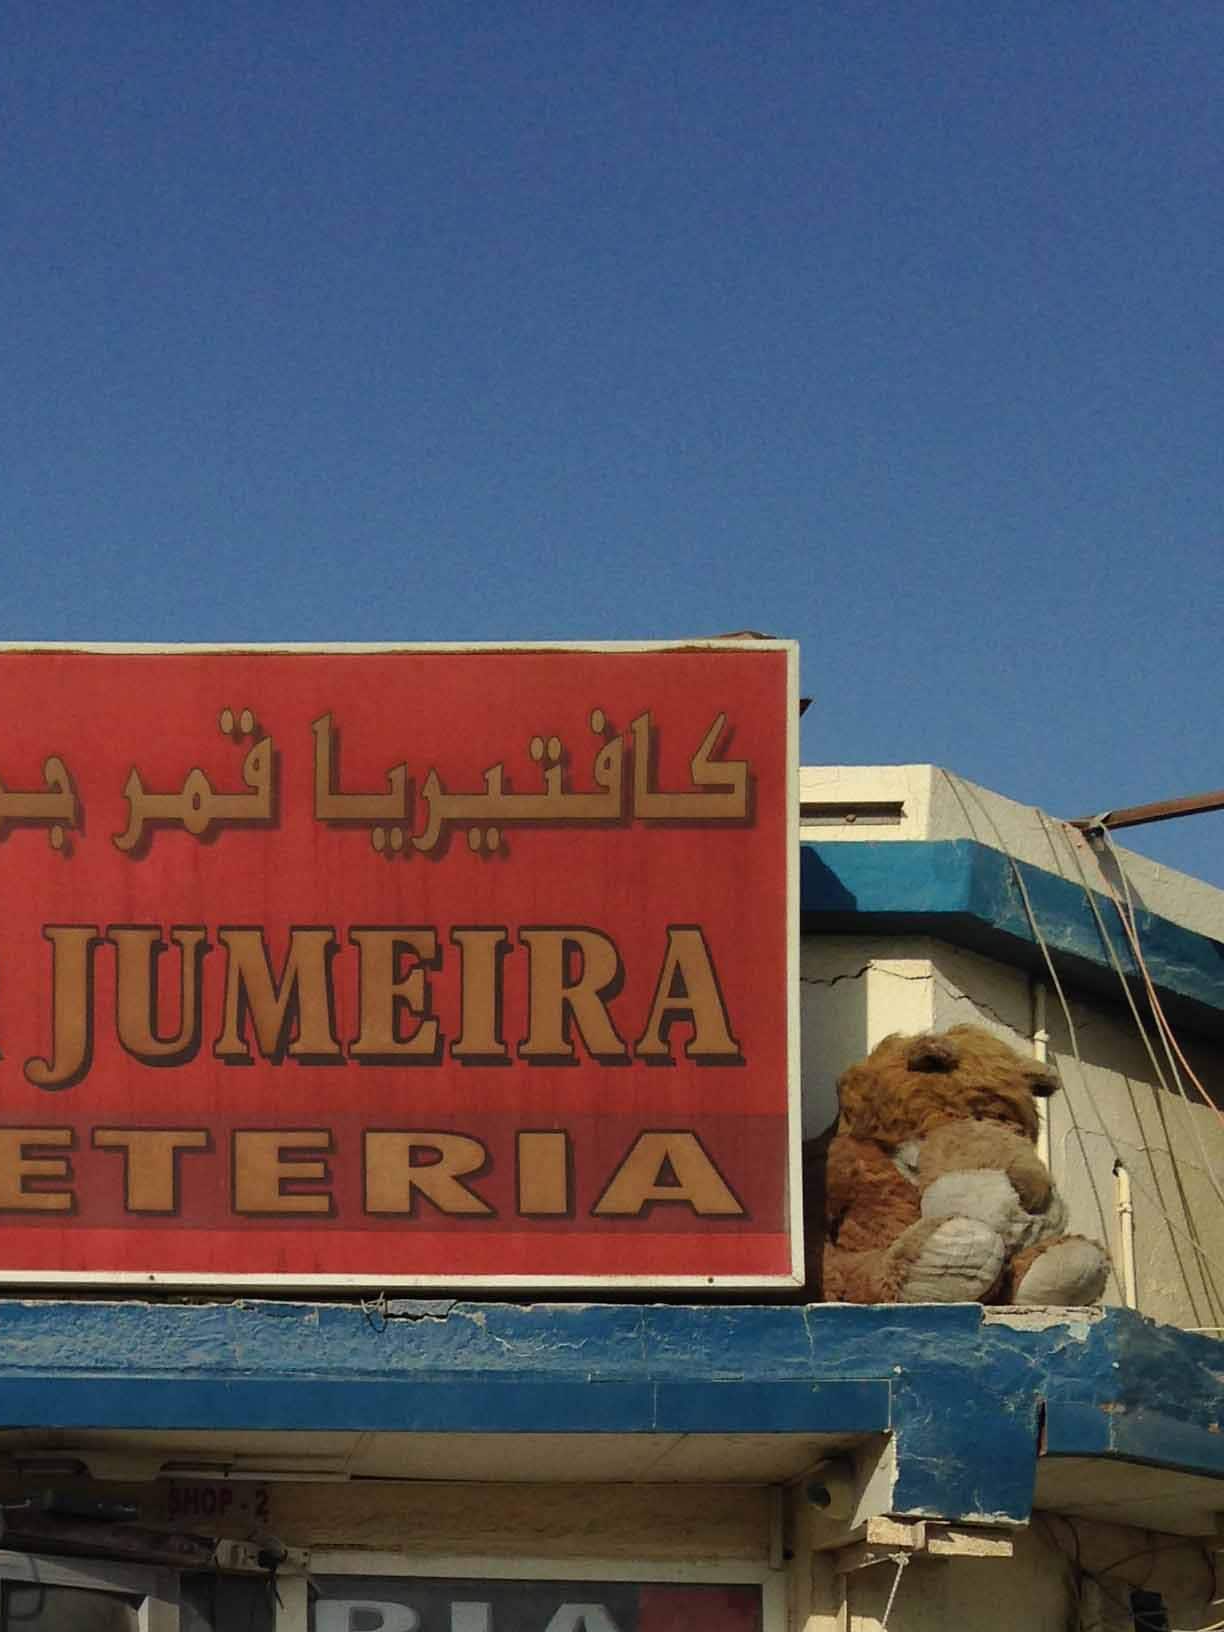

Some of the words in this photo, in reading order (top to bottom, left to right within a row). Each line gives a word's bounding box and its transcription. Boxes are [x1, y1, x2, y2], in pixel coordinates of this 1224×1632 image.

[112, 706, 275, 852] قمر
[312, 707, 751, 852] كافتيريا
[24, 922, 747, 1091] JUMEIRA
